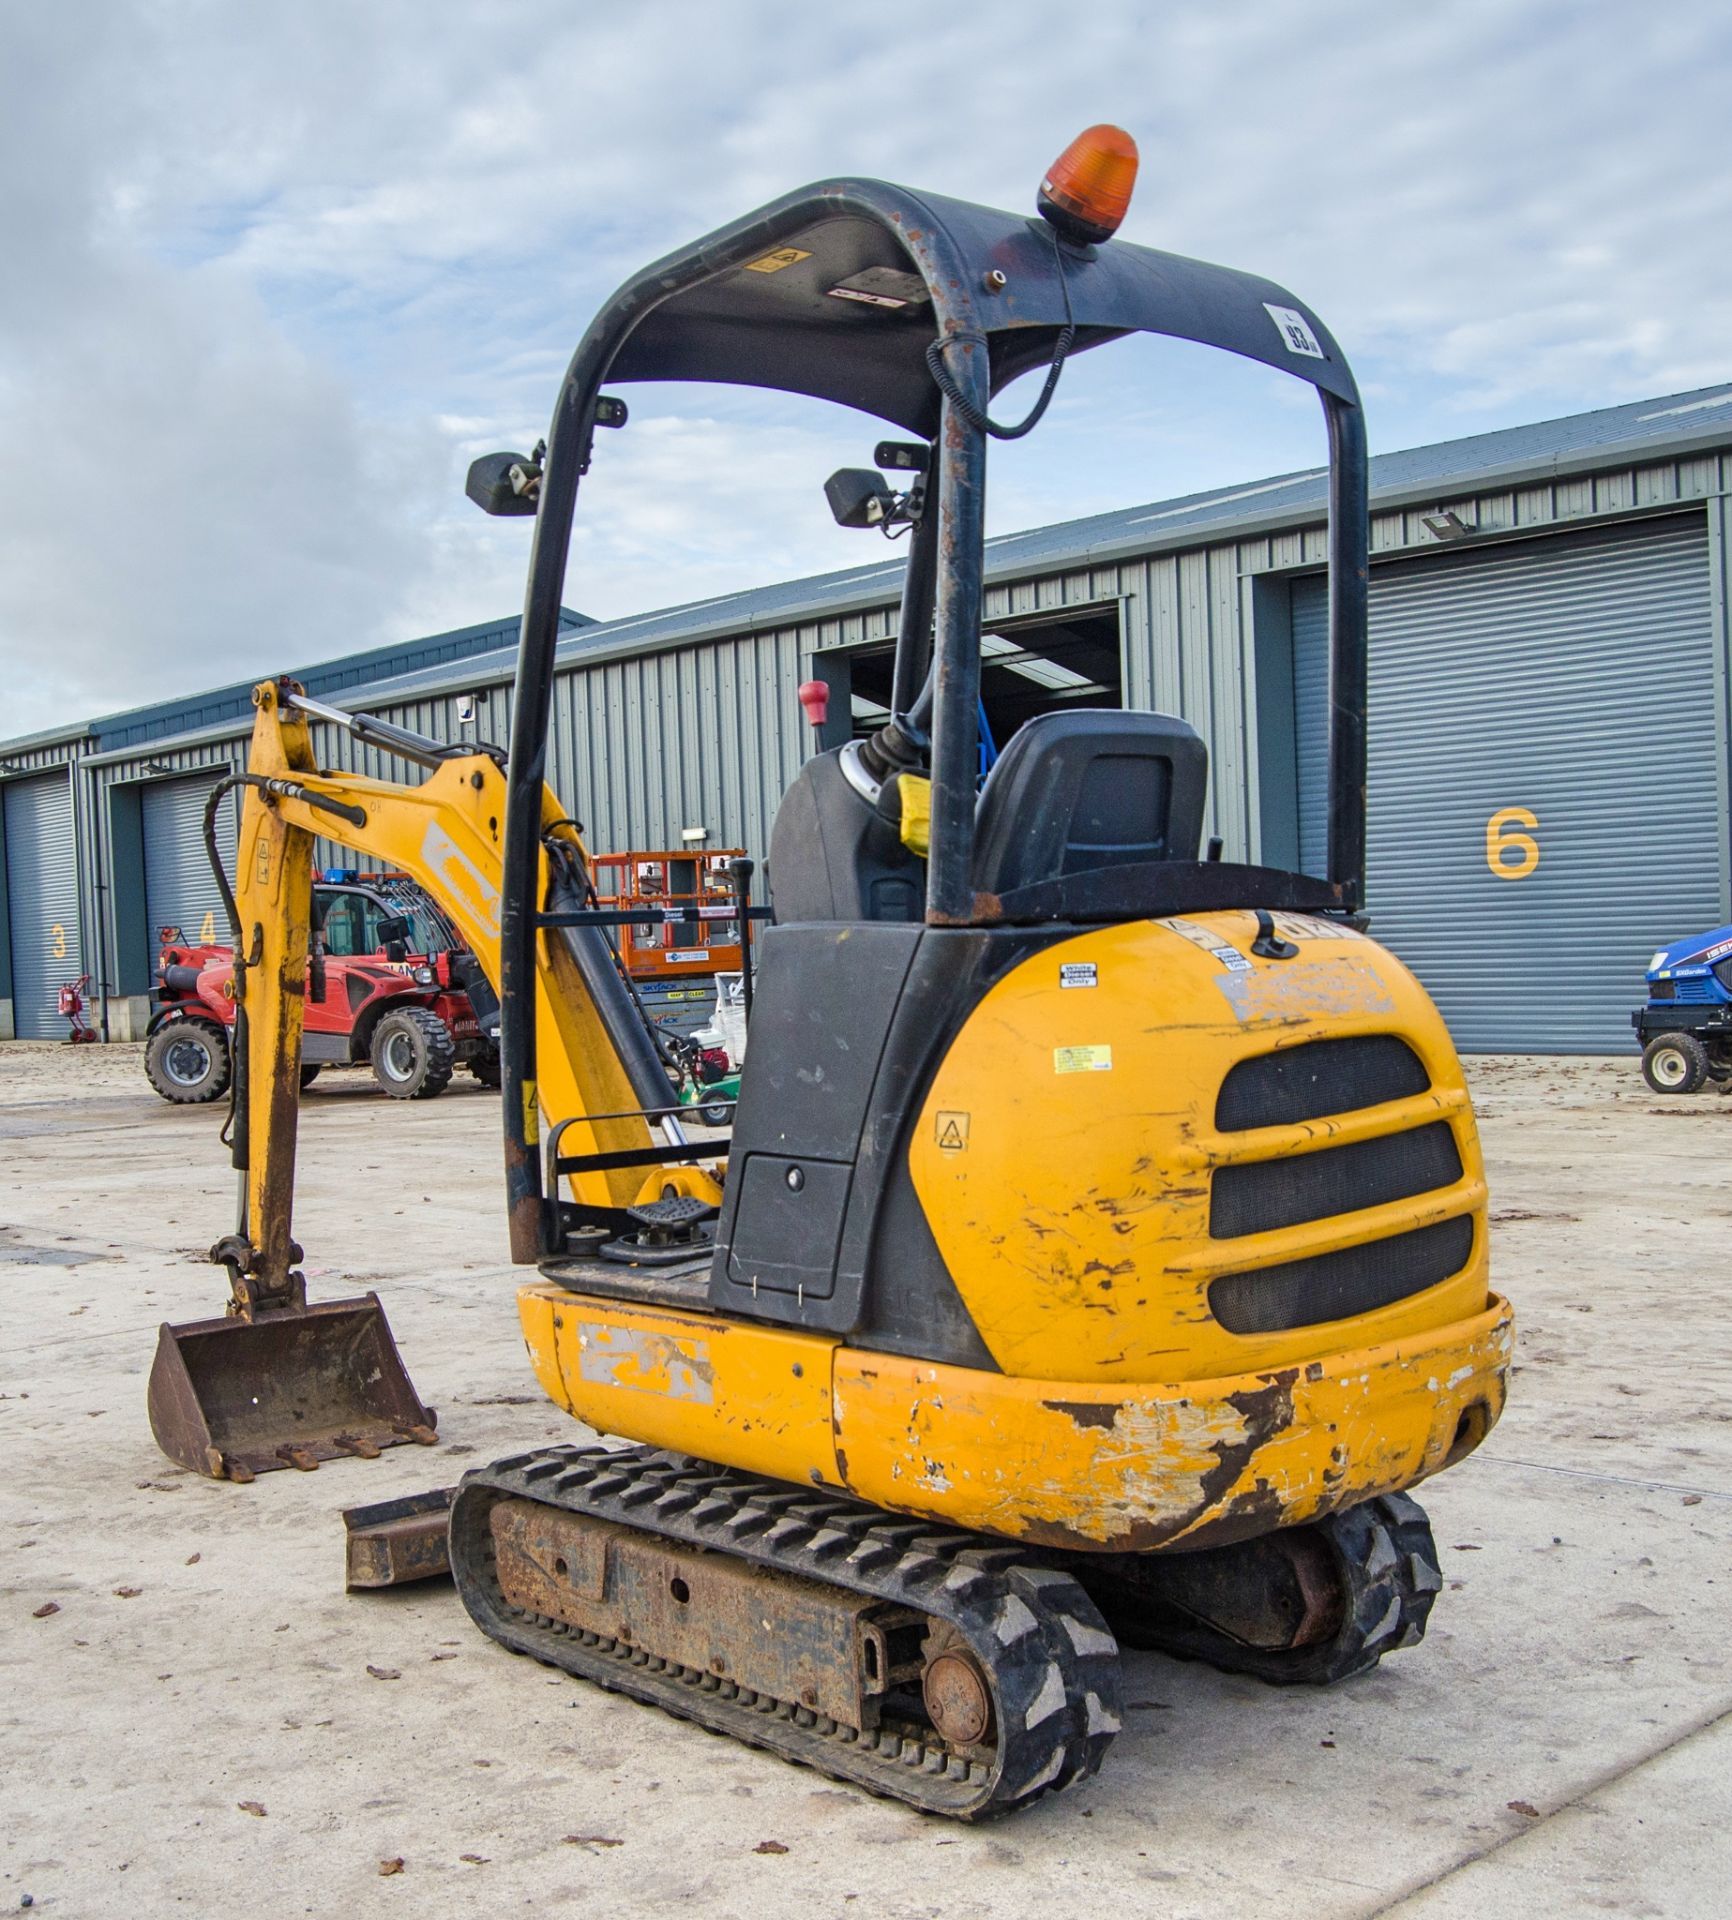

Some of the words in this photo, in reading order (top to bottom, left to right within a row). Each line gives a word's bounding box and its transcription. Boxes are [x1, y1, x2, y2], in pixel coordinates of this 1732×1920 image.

[1285, 325, 1310, 351] 93
[1486, 806, 1540, 880] 6
[51, 923, 66, 959] 3
[199, 911, 216, 946] 4
